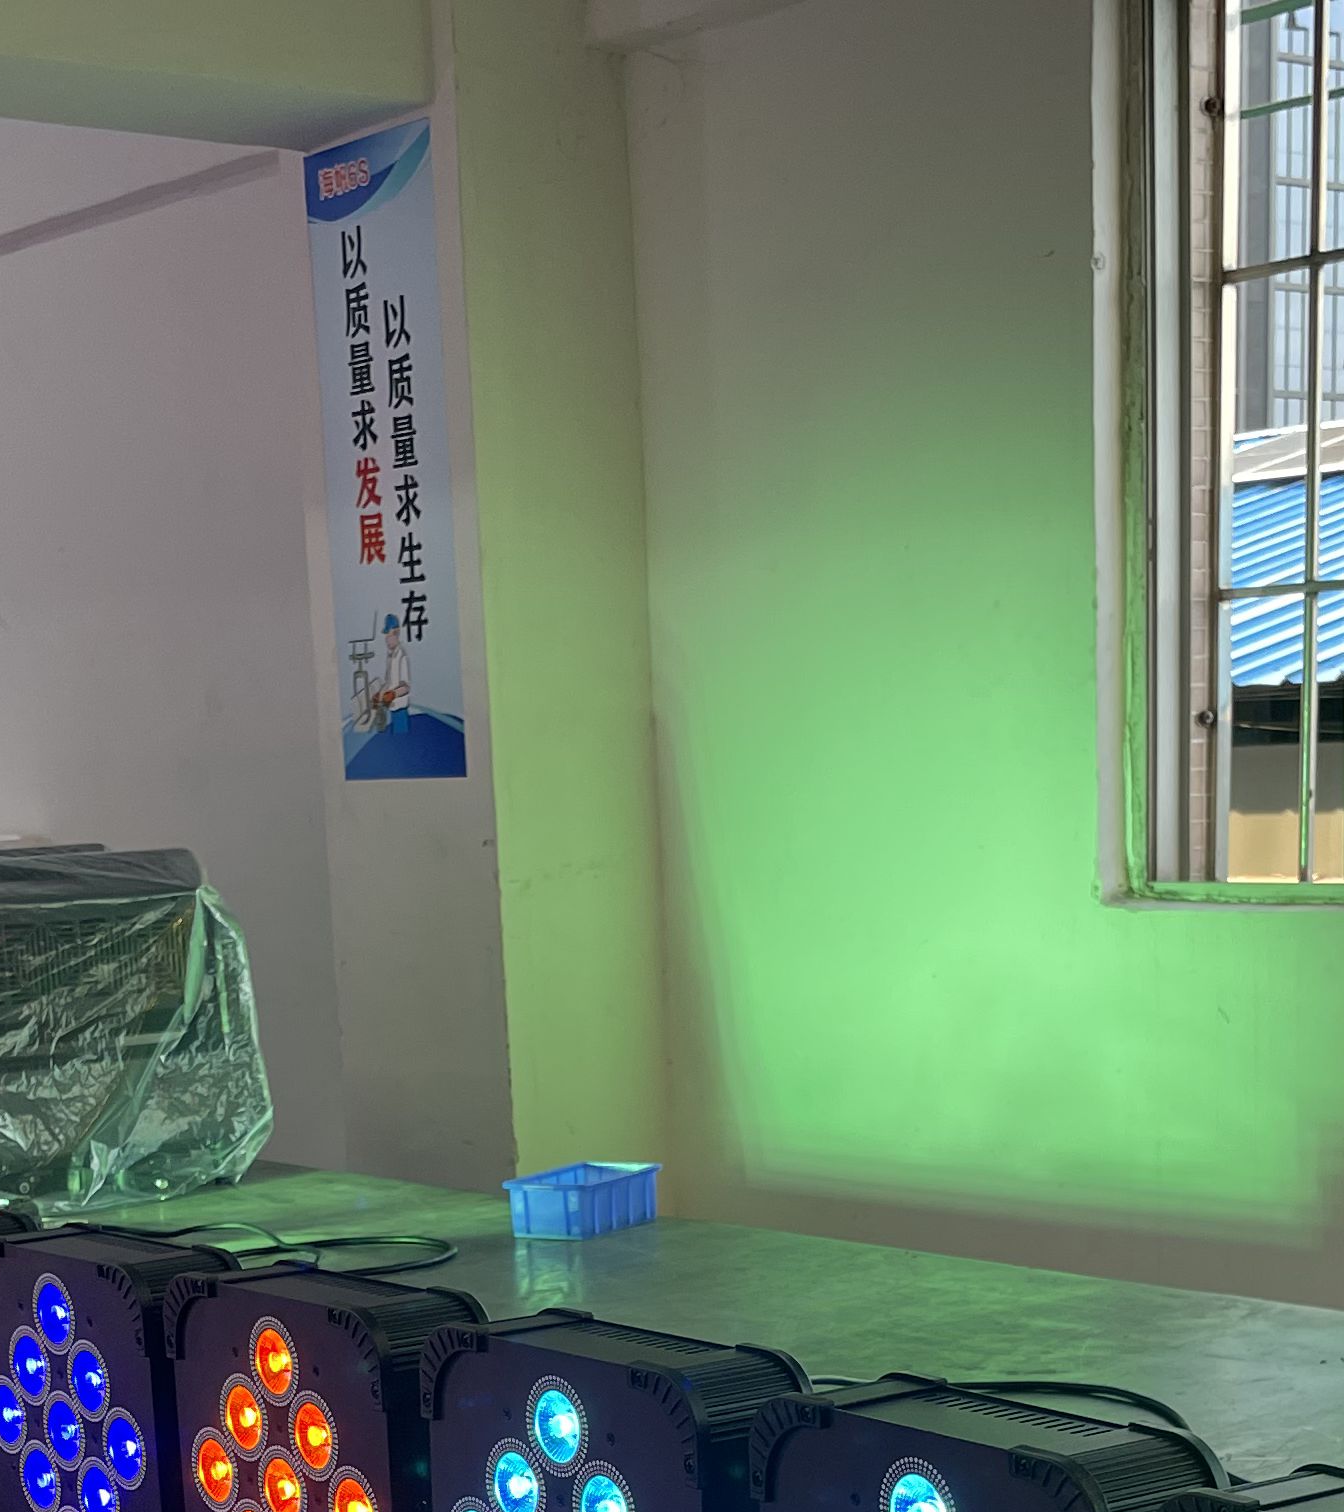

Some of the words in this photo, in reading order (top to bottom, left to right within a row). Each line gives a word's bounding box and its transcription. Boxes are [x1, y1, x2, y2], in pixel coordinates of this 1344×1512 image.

[340, 225, 387, 566] 以质量求发展
[382, 294, 429, 643] 以质量求生存
